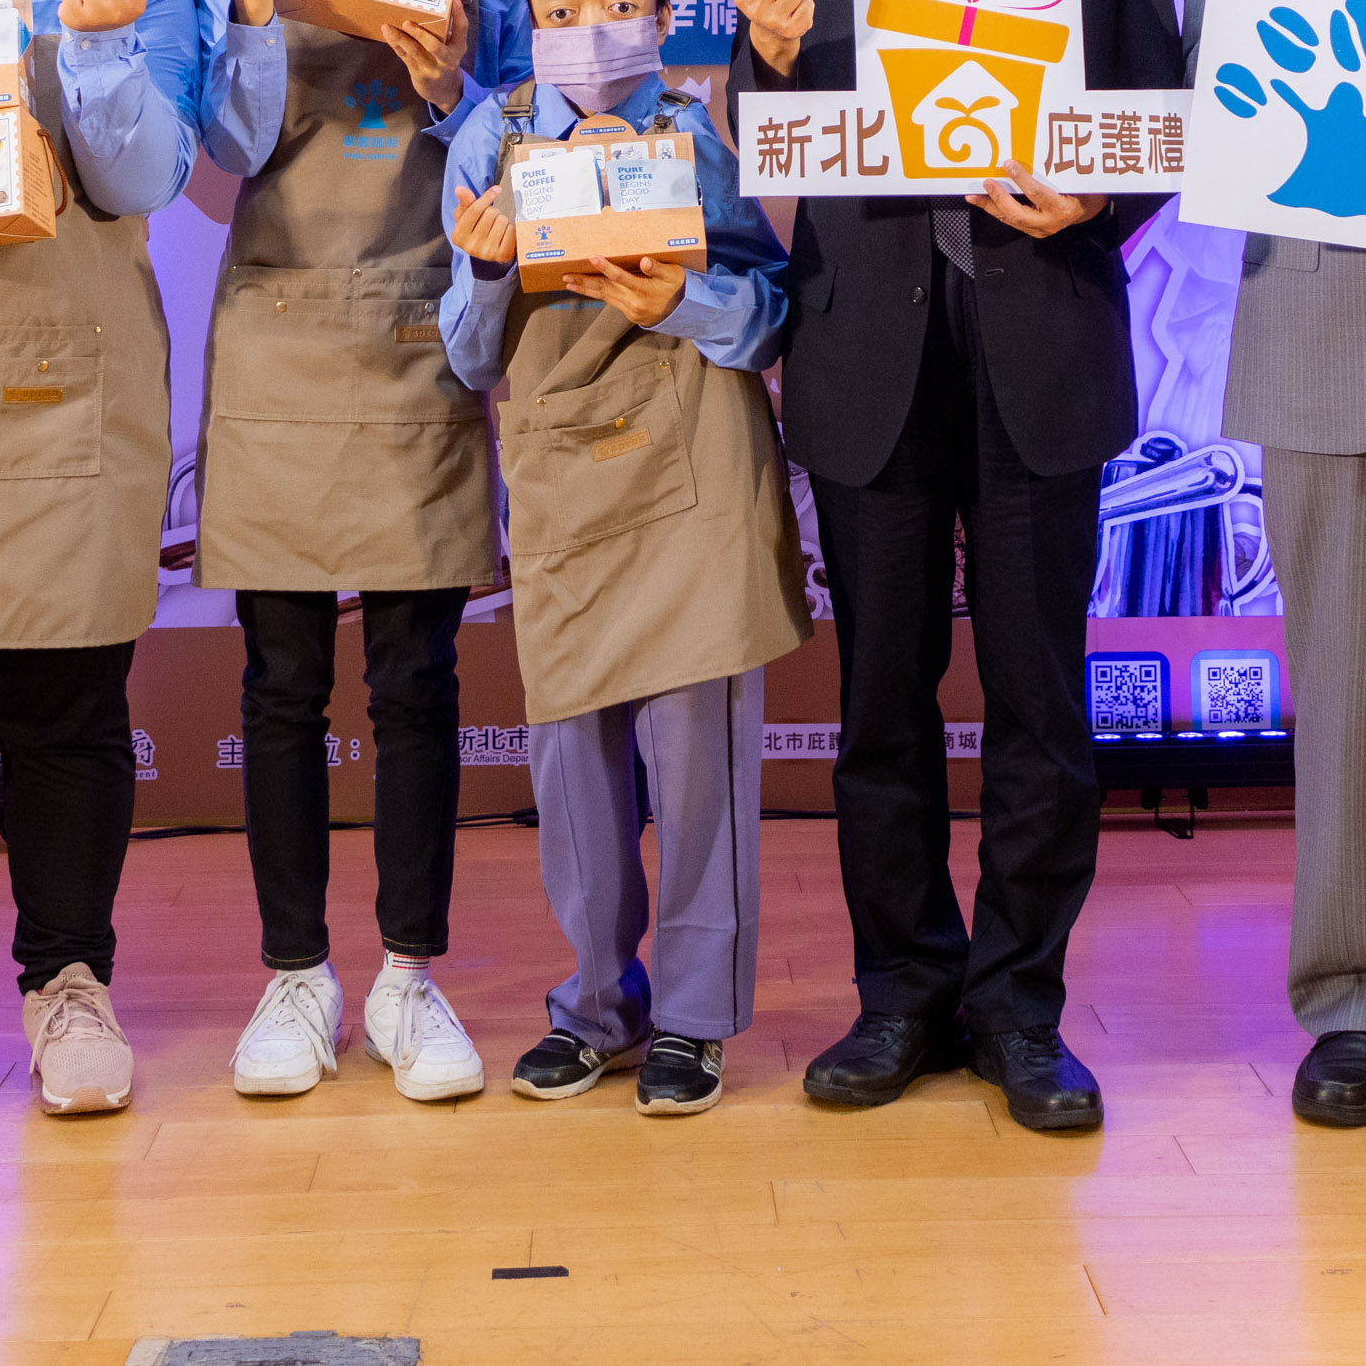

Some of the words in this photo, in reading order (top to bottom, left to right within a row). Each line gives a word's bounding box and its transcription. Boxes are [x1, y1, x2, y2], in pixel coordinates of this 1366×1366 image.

[756, 107, 890, 179] 新北
[1044, 106, 1185, 177] 庇護禮
[522, 168, 546, 179] PURE
[617, 166, 644, 174] PURE
[618, 173, 654, 181] COFFEE
[523, 176, 555, 188] COFFEE
[619, 180, 652, 189] BEGINS
[524, 186, 554, 198] BEGINS
[620, 188, 650, 197] GOOD
[525, 195, 552, 205] GOOD
[621, 196, 640, 205] DAY
[526, 205, 544, 216] DAY
[473, 754, 501, 763] Affairs
